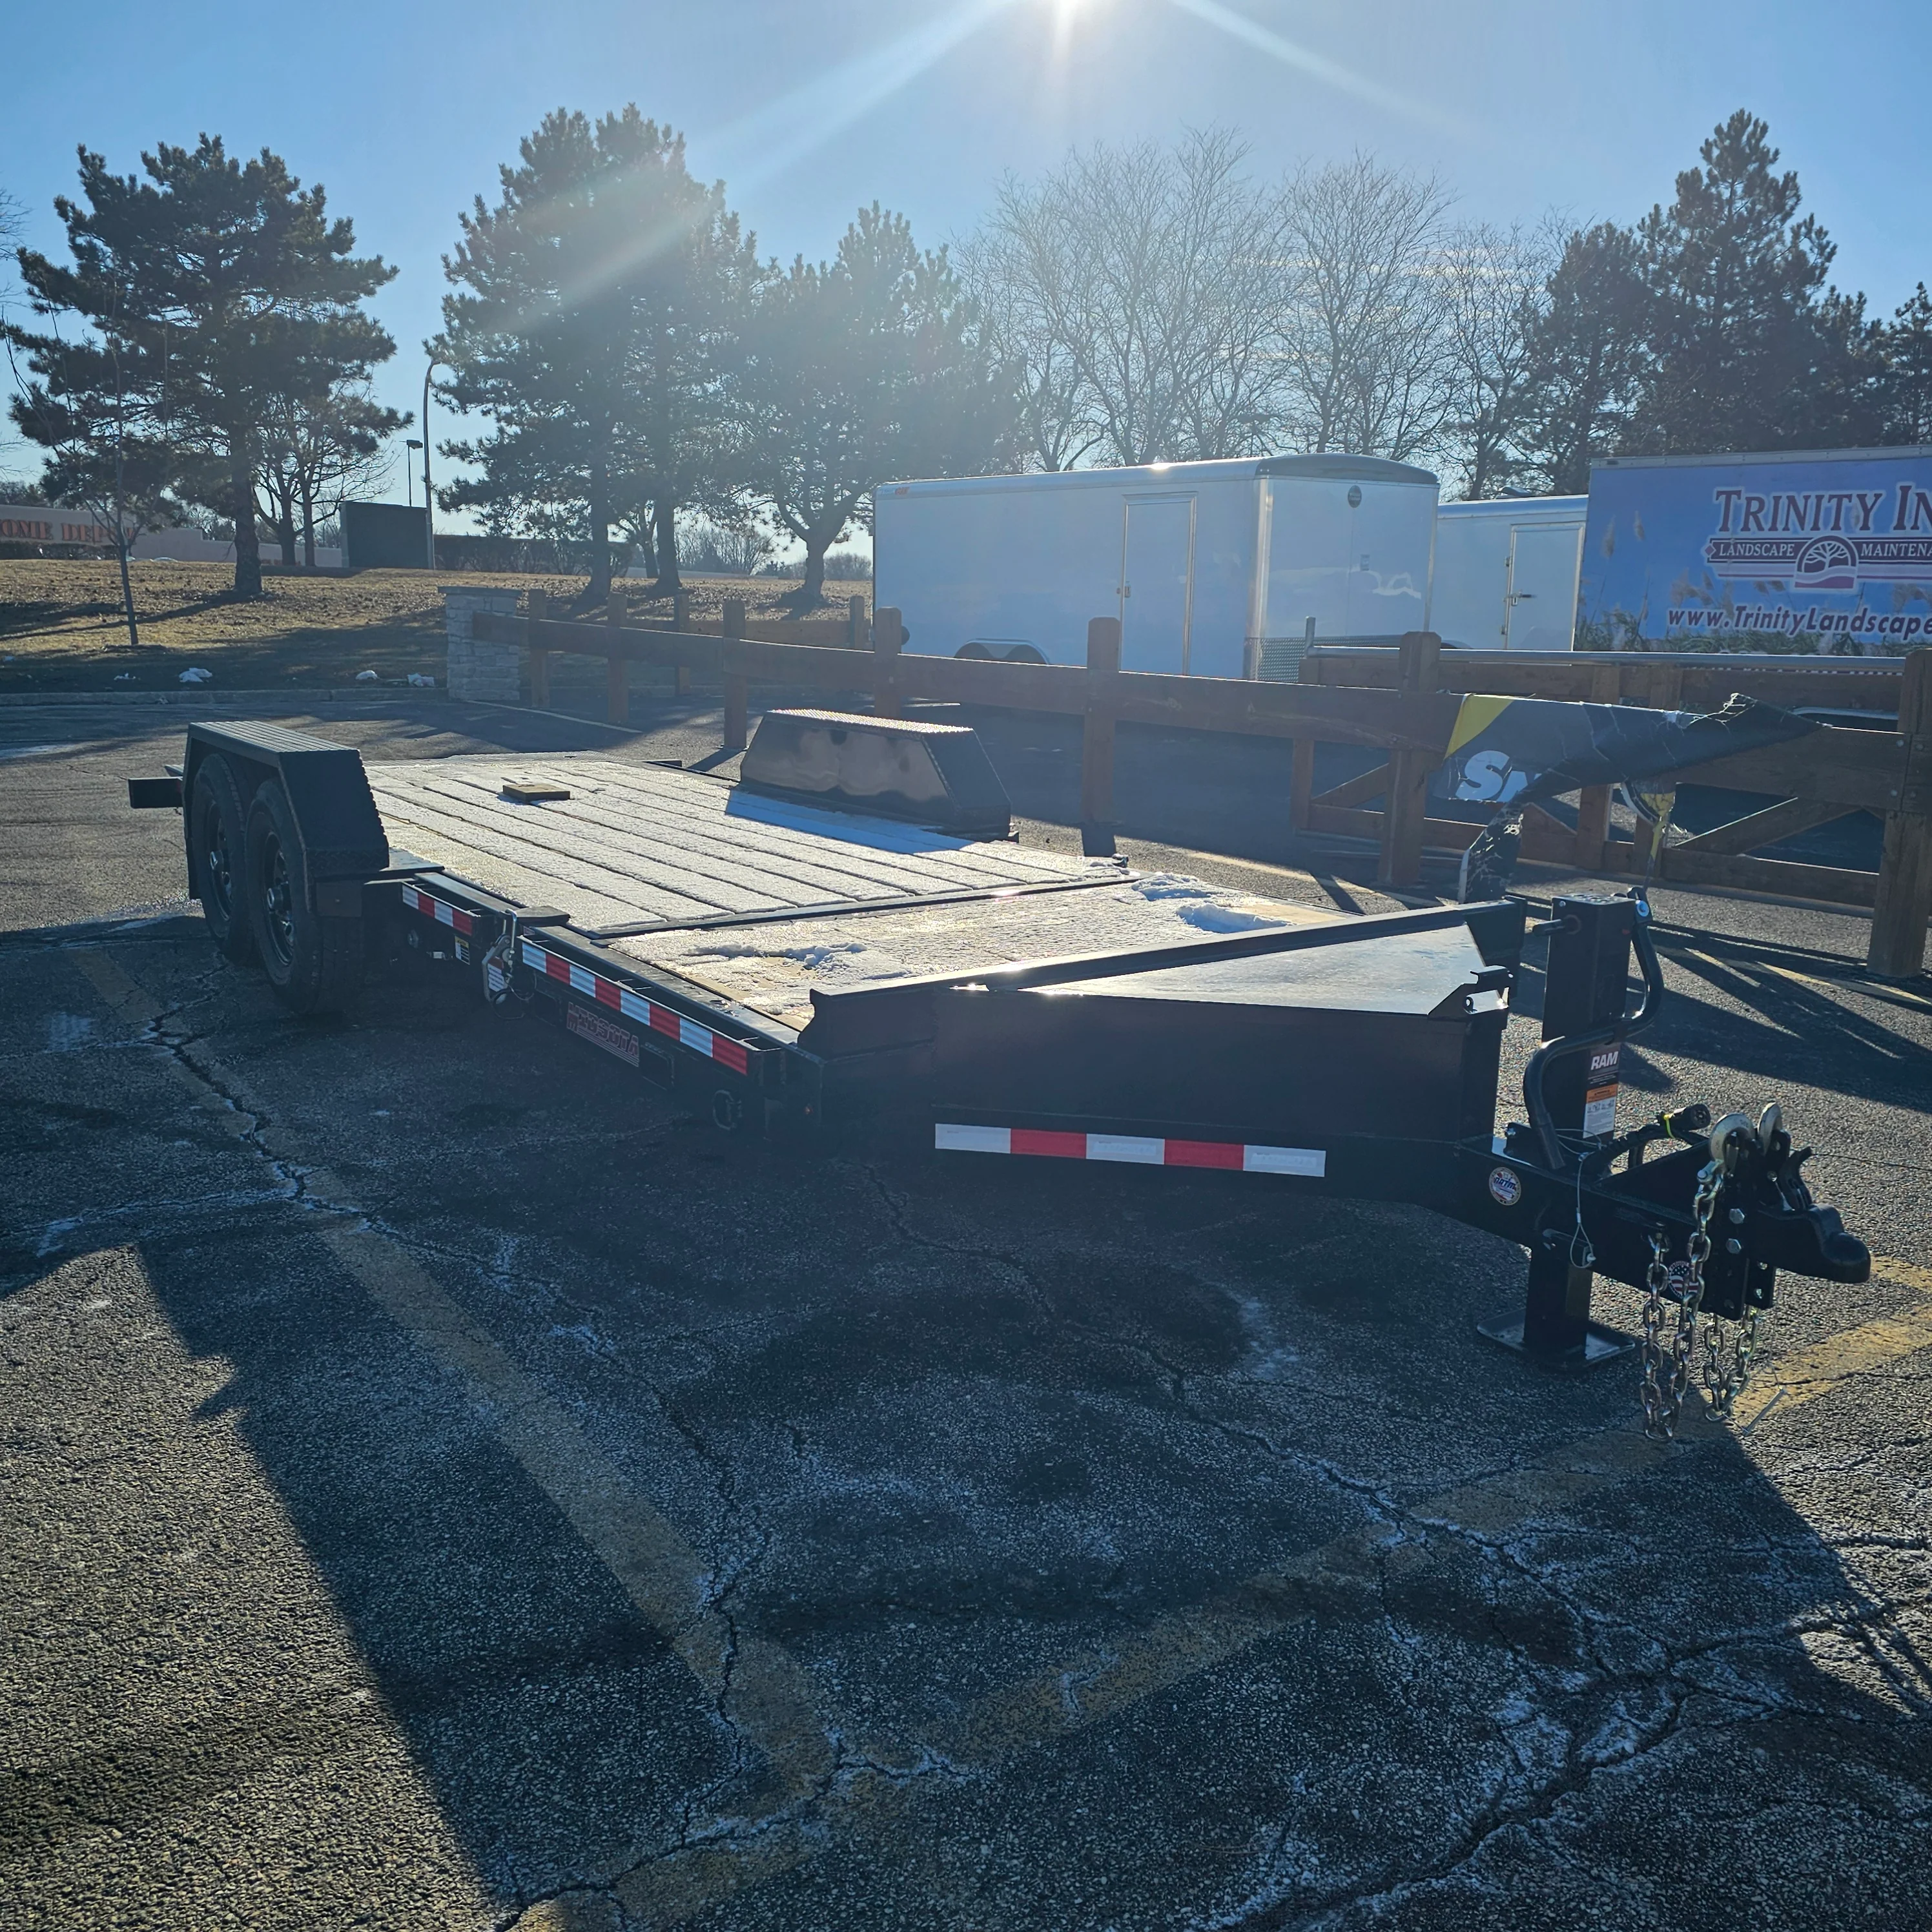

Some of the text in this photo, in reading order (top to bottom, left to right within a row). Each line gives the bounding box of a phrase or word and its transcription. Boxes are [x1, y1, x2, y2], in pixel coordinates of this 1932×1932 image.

[1715, 489, 1883, 532] TRINITY
[0, 519, 136, 543] OME DEP
[1719, 542, 1795, 557] LANDSCAPE
[1668, 605, 1932, 641] www.TrinityLandscape
[566, 1001, 639, 1057] MIDSOTA
[1590, 1051, 1619, 1071] RAM
